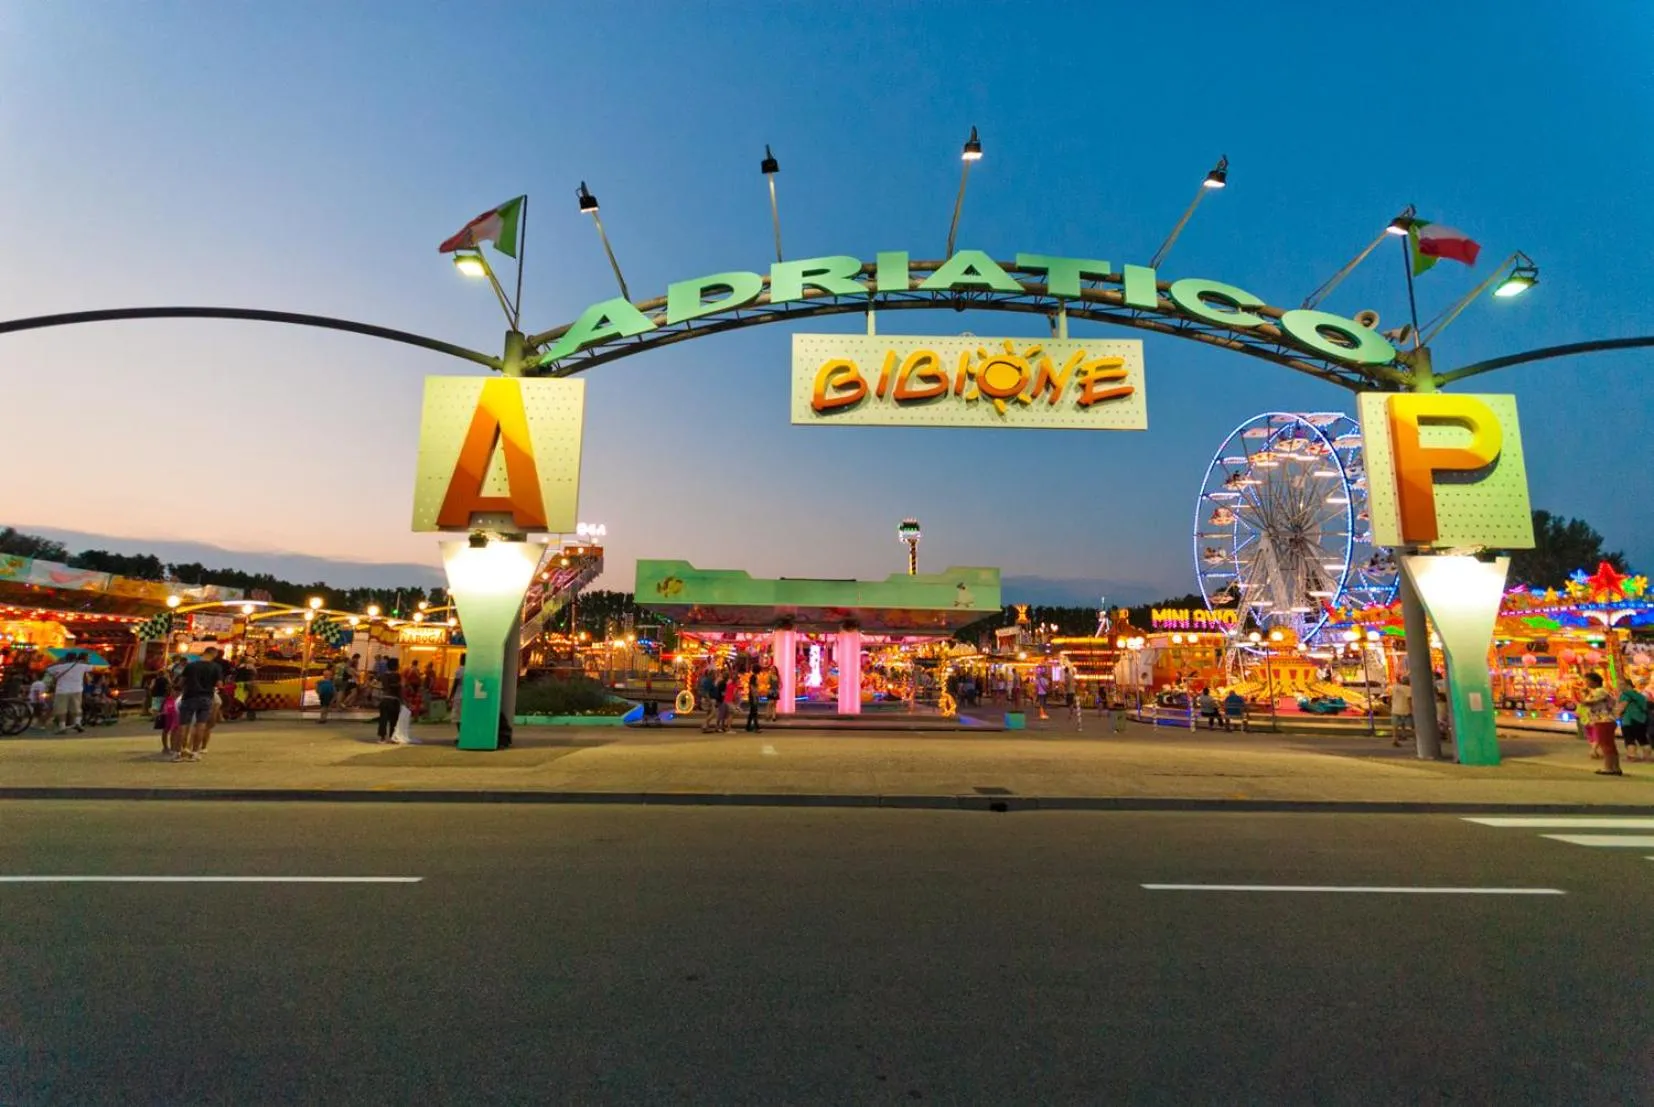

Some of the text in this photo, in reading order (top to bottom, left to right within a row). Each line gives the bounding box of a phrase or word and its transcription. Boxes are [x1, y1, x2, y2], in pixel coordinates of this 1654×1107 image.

[540, 249, 1396, 365] ADRIATICO
[810, 340, 1135, 415] BIBIONE
[436, 377, 549, 531] A
[1385, 394, 1503, 543] P
[1151, 608, 1190, 629] MINI
